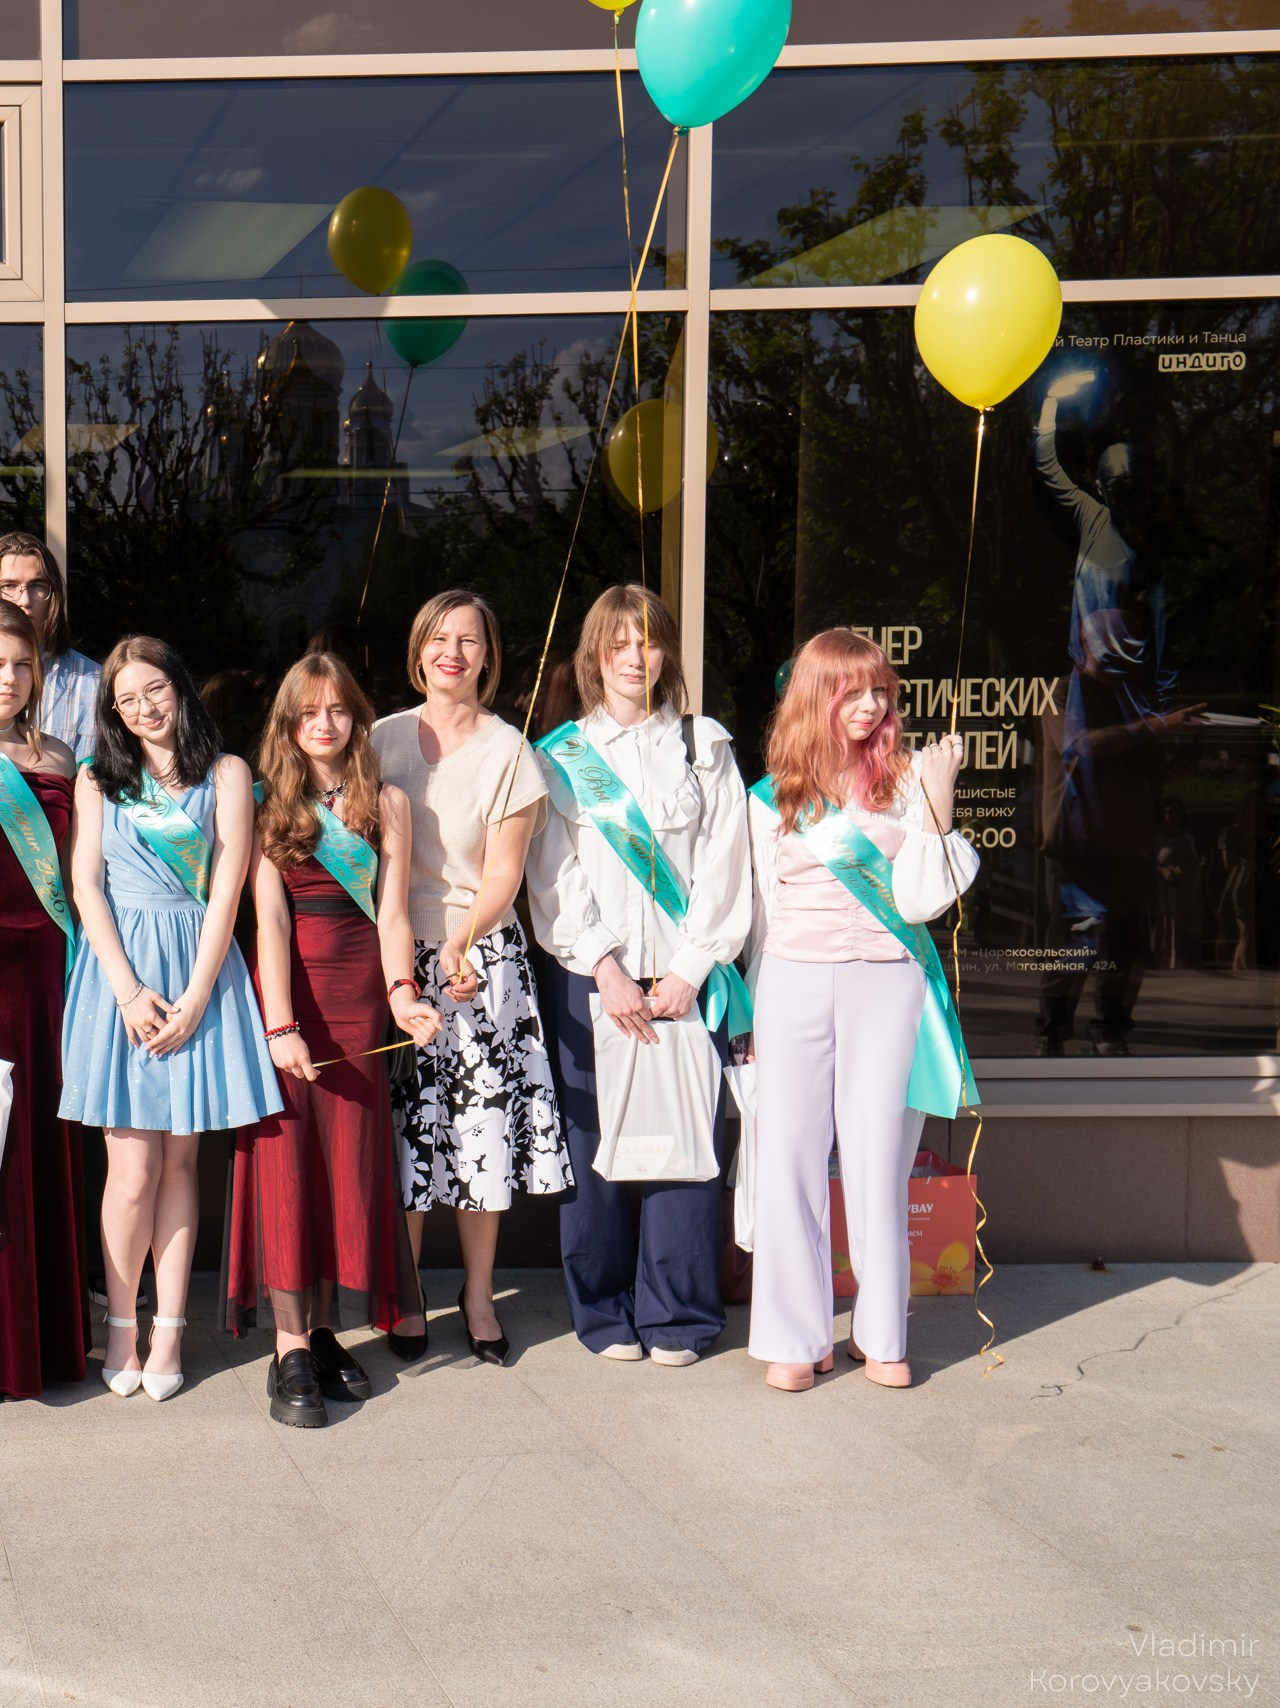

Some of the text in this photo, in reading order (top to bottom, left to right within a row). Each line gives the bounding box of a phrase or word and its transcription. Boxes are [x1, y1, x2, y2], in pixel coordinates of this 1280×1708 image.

[1069, 335, 1109, 349] Театр
[1114, 334, 1185, 345] Пластики
[1189, 334, 1198, 343] и
[1203, 331, 1246, 345] Танца
[898, 676, 1059, 718] СТИЧЕСКИХ
[976, 807, 1016, 818] ВИЖУ
[971, 945, 1097, 960] «Царскосельский»
[985, 963, 1002, 974] ул.
[1006, 959, 1089, 973] Магазейная,
[1092, 961, 1117, 971] 42А
